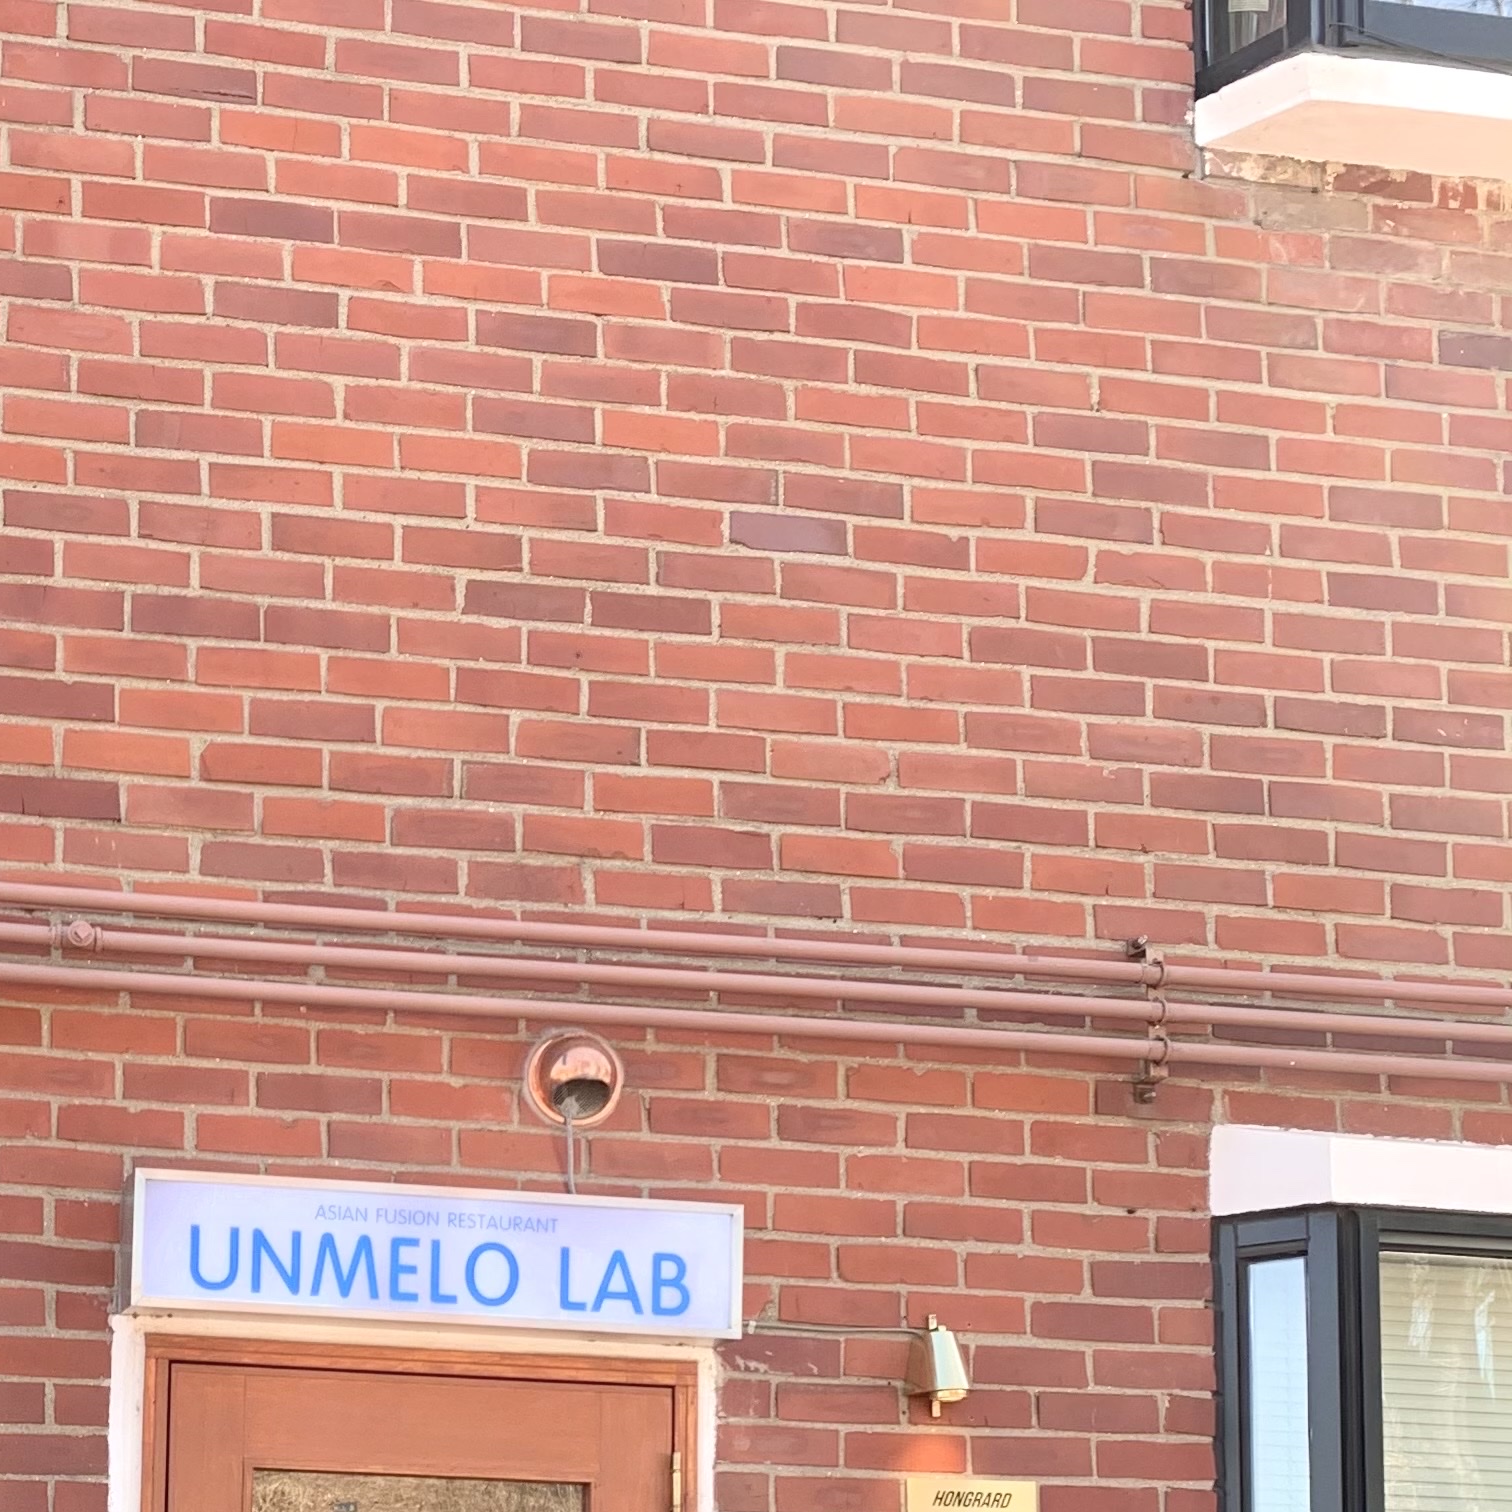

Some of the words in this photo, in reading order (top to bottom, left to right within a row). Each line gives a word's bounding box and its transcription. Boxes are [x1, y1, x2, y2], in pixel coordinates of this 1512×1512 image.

[314, 1203, 368, 1222] ASIAN
[375, 1207, 441, 1227] FUSION
[446, 1211, 559, 1234] RESTAURANT
[189, 1223, 520, 1307] UNMELO
[559, 1245, 692, 1316] LAB
[932, 1490, 1012, 1509] HONGRARD
